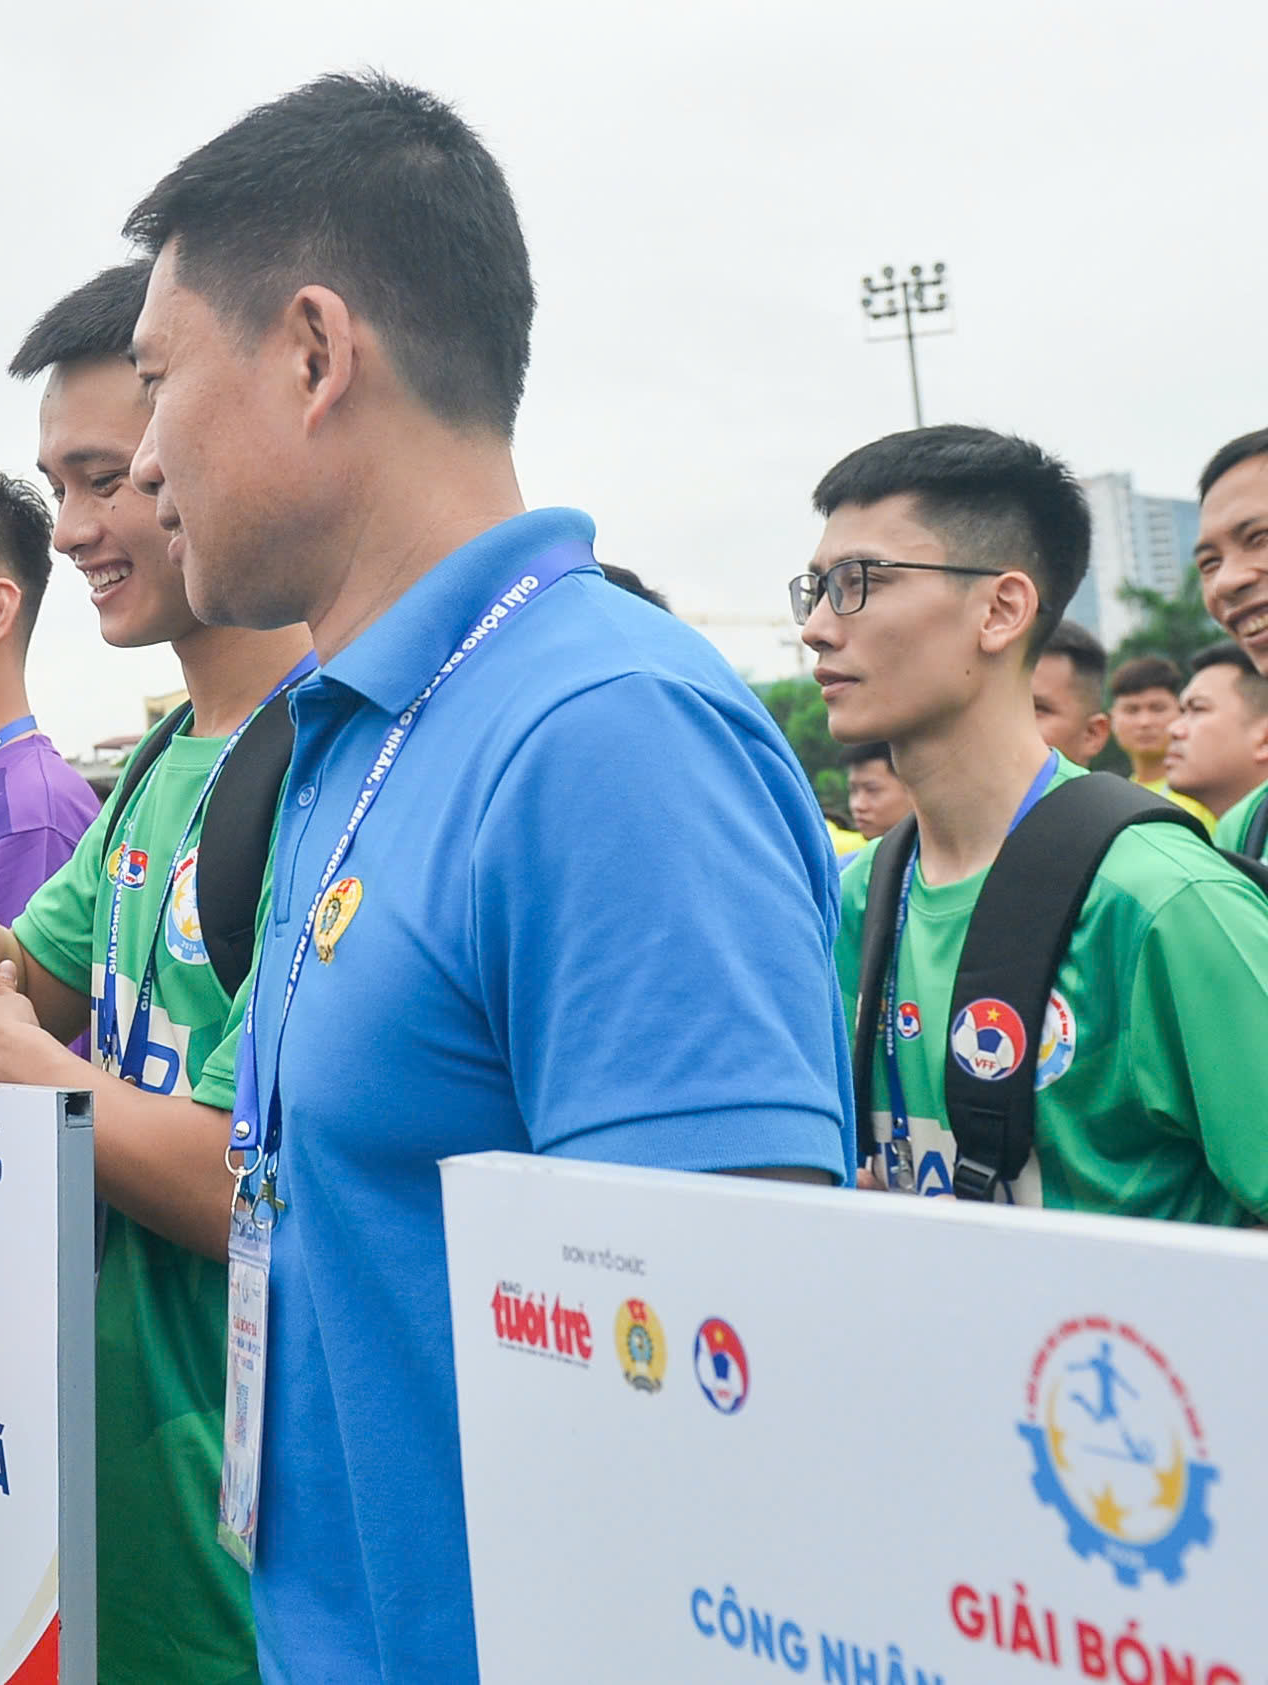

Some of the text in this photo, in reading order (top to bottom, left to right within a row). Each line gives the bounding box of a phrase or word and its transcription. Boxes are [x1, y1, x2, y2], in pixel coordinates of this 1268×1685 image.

[501, 575, 539, 608] GIẢI
[461, 603, 509, 651] BÓNG
[110, 905, 121, 945] BÓNG
[108, 945, 117, 974] GIẢI
[290, 935, 307, 982] NAM
[974, 1057, 997, 1071] VFF
[551, 1292, 594, 1361] trẻ
[691, 1585, 808, 1673] CÔNG
[950, 1583, 1060, 1667] GIẢI
